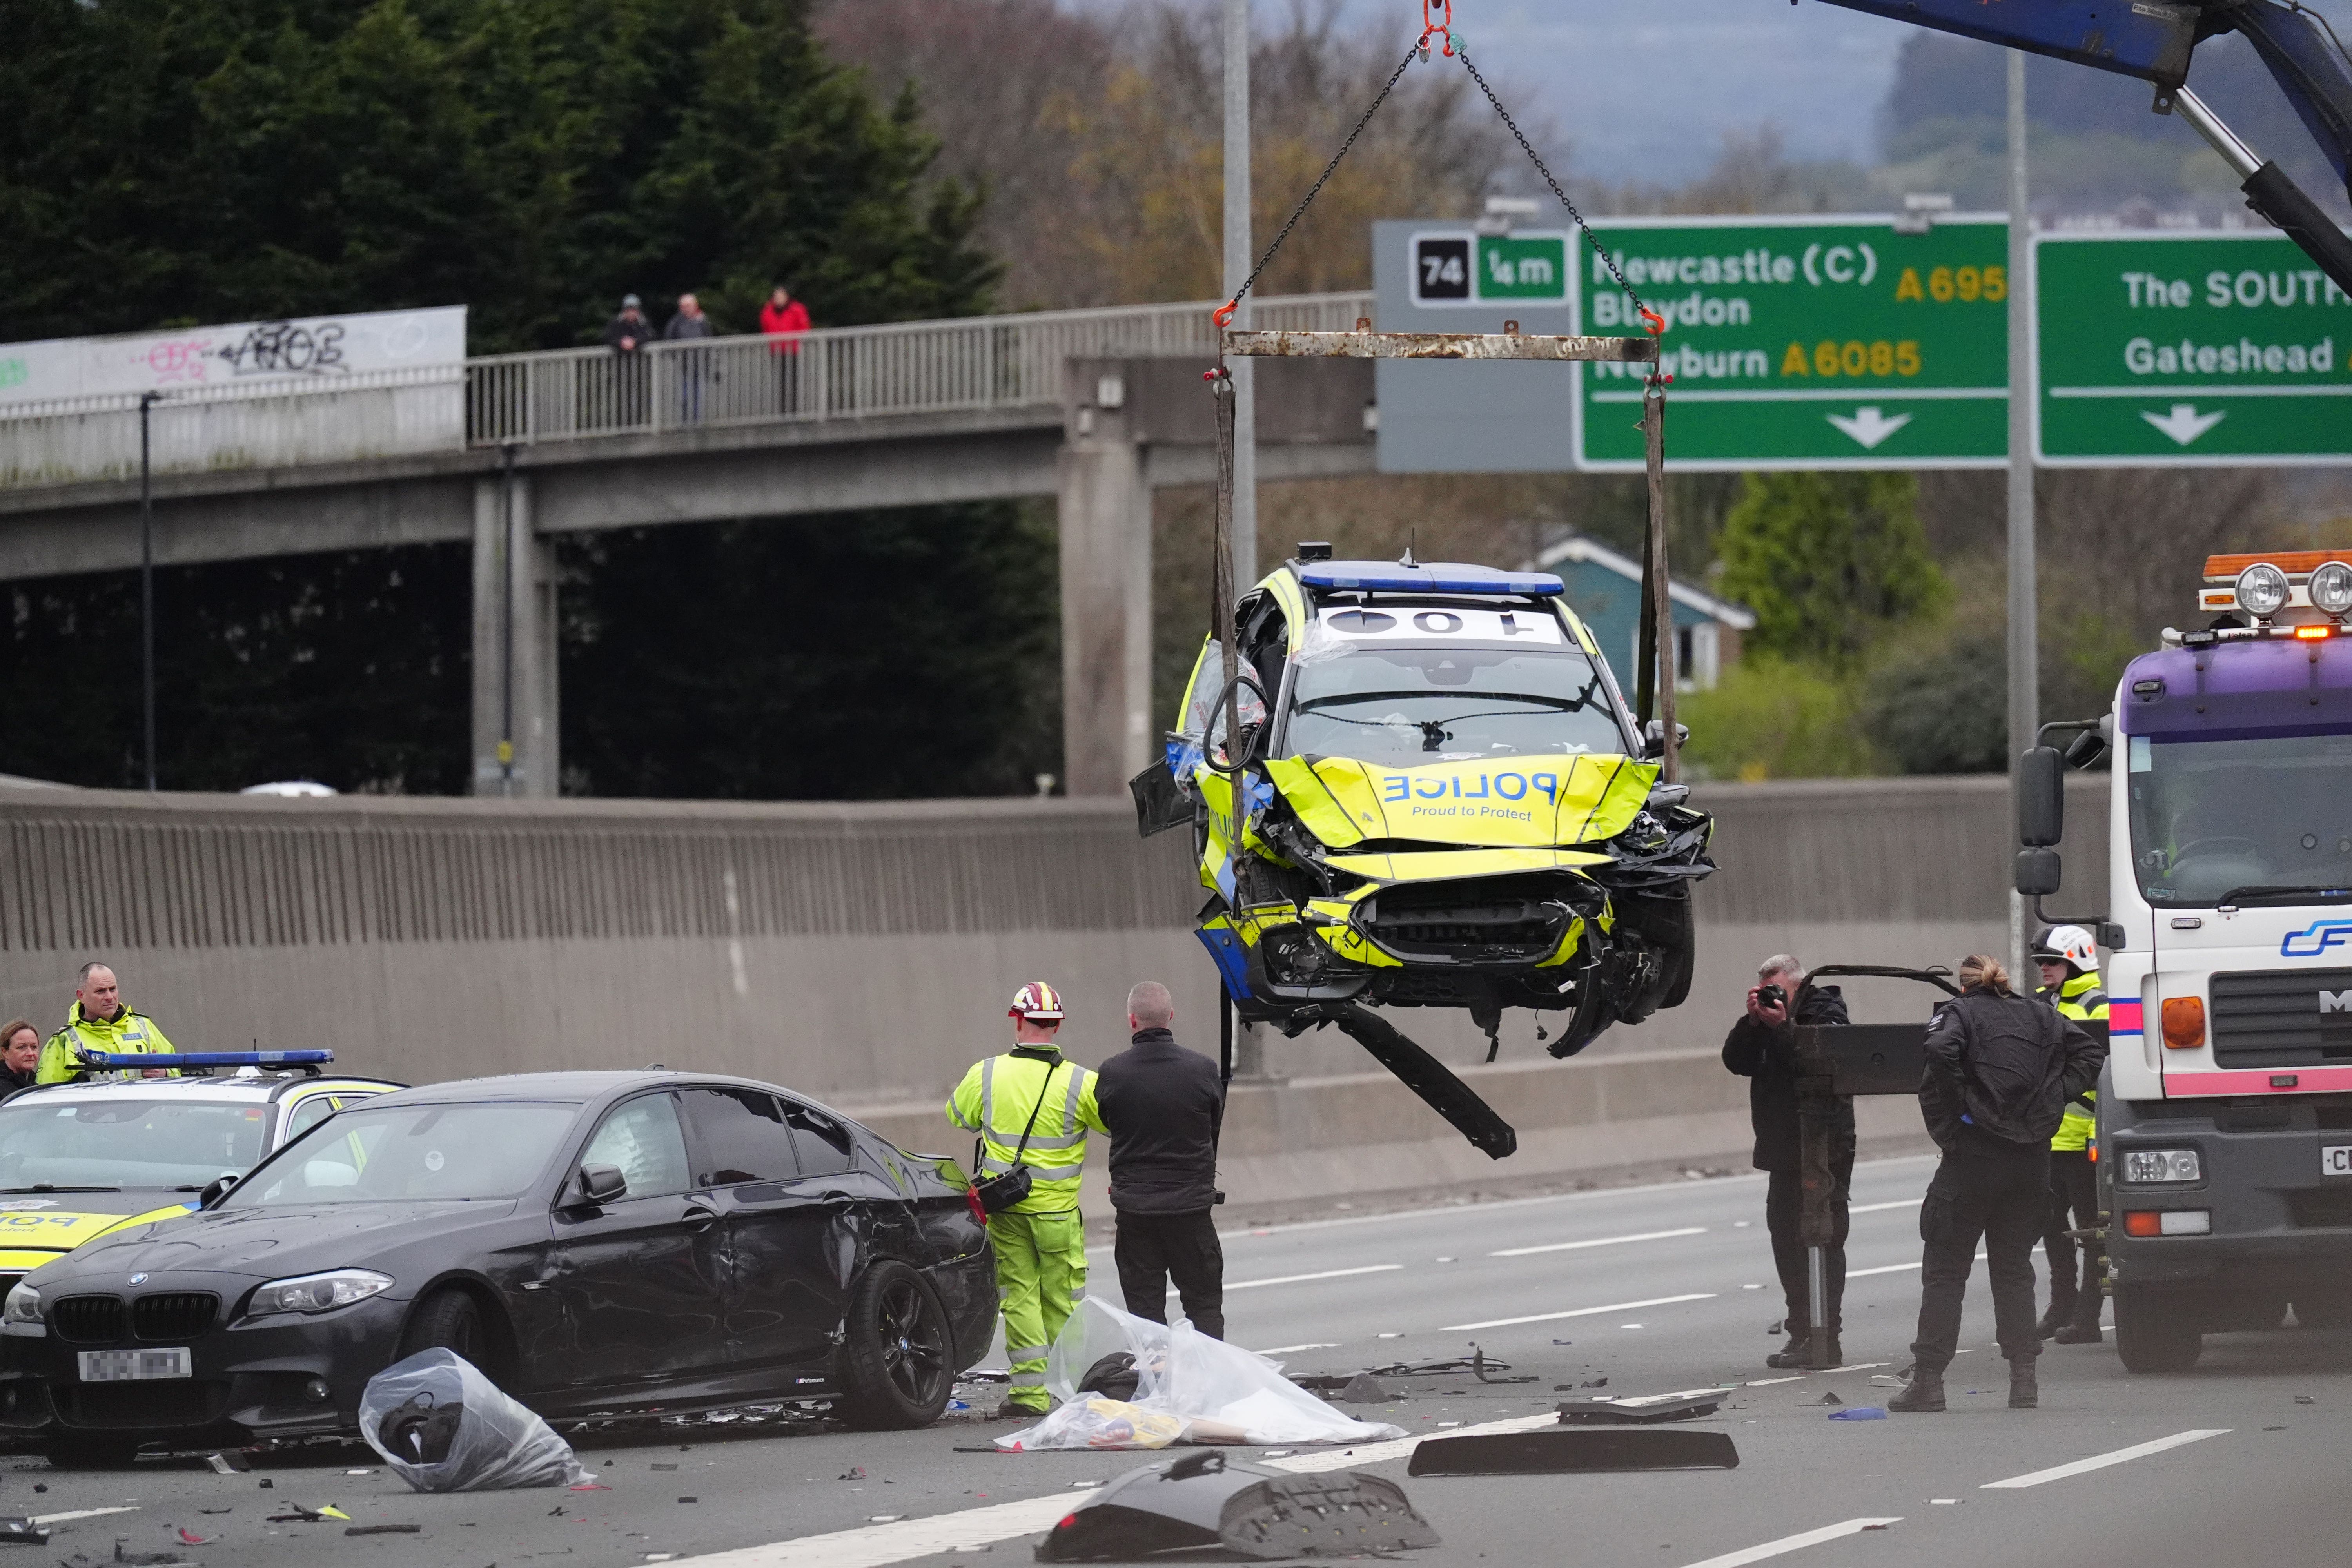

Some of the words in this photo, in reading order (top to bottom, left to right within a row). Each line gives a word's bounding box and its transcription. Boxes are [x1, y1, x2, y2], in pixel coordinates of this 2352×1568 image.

[1421, 256, 1465, 286] 74
[1592, 249, 1795, 285] Newcastle
[1803, 243, 1877, 287] (C)
[2121, 271, 2192, 308] The
[2125, 336, 2334, 374] Gateshead
[1412, 806, 1456, 816] Proud
[1461, 806, 1475, 816] to
[1481, 806, 1532, 821] Protect
[2334, 1149, 2352, 1171] C
